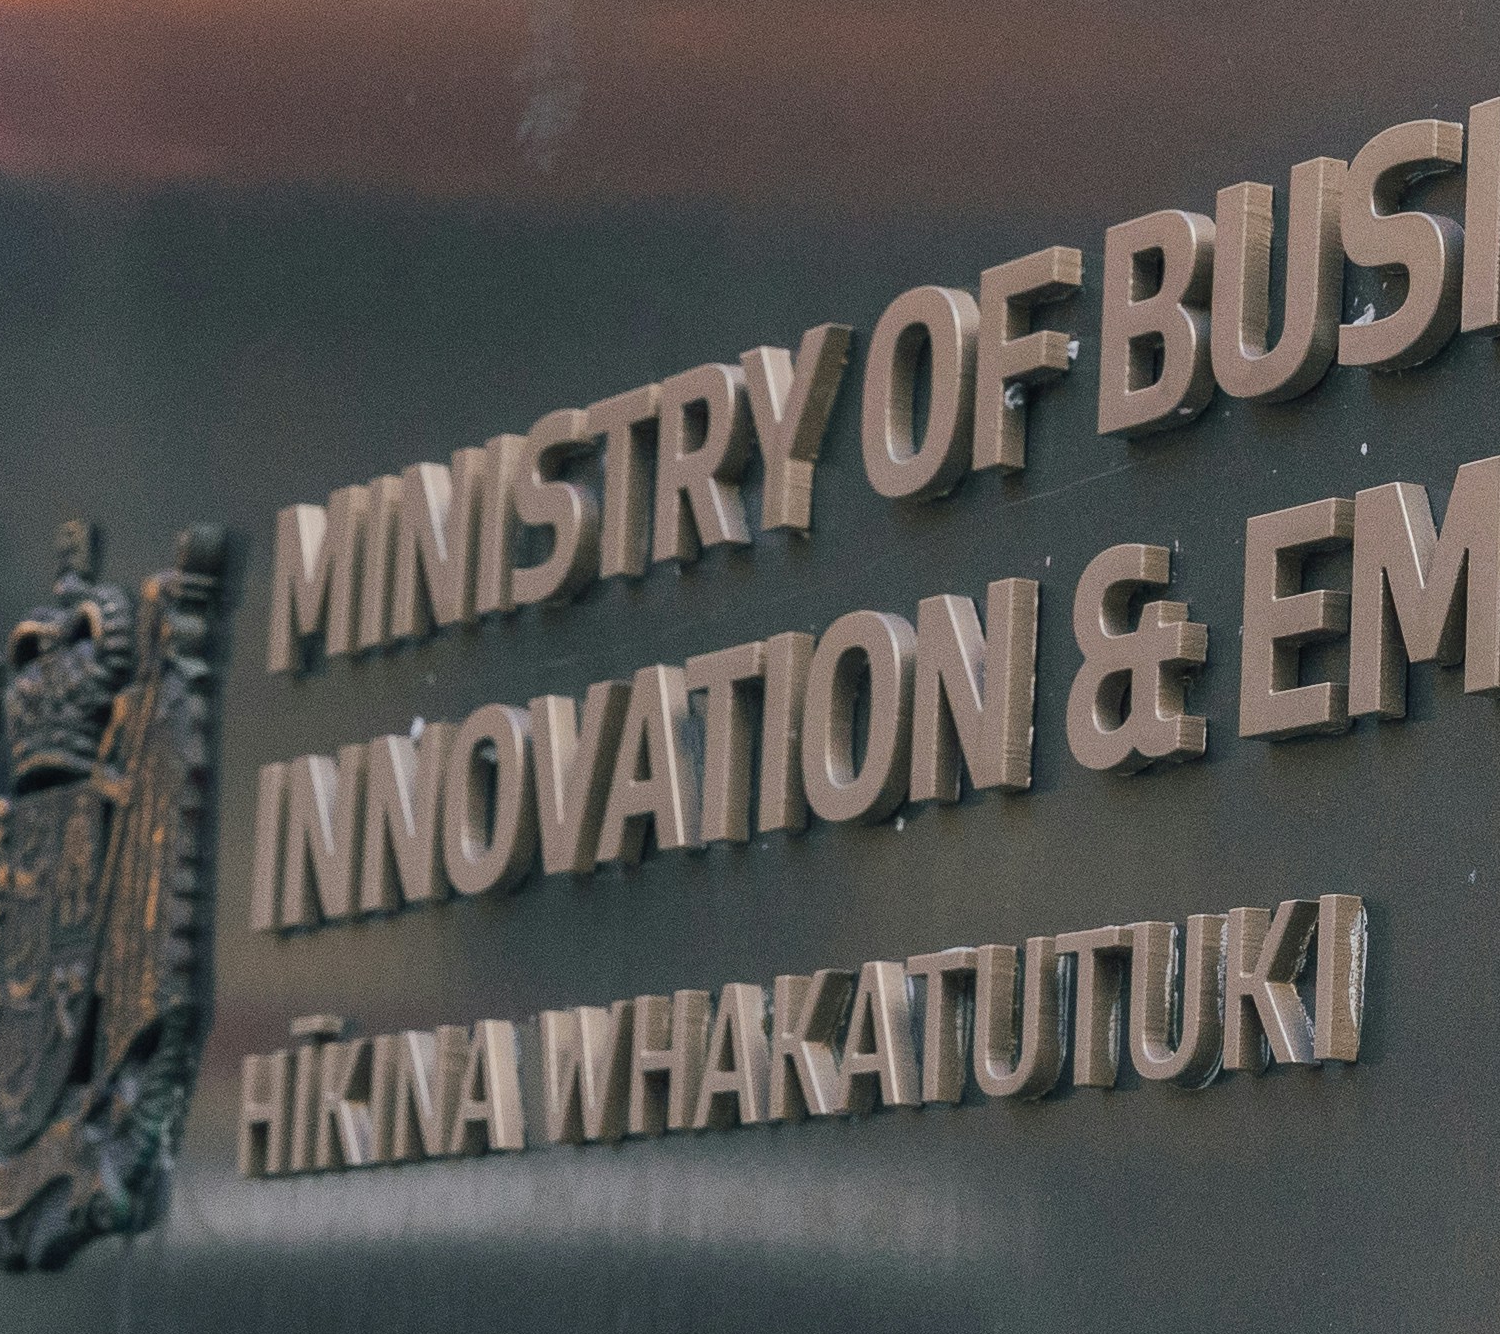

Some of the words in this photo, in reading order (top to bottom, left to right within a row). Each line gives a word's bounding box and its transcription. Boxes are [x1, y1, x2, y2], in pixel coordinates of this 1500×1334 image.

[267, 323, 851, 674] MINISTRY
[861, 244, 1082, 504] OF
[252, 577, 1039, 933] INNOVATION
[1067, 544, 1206, 774] &
[539, 894, 1366, 1143] WHAKATUTUKI
